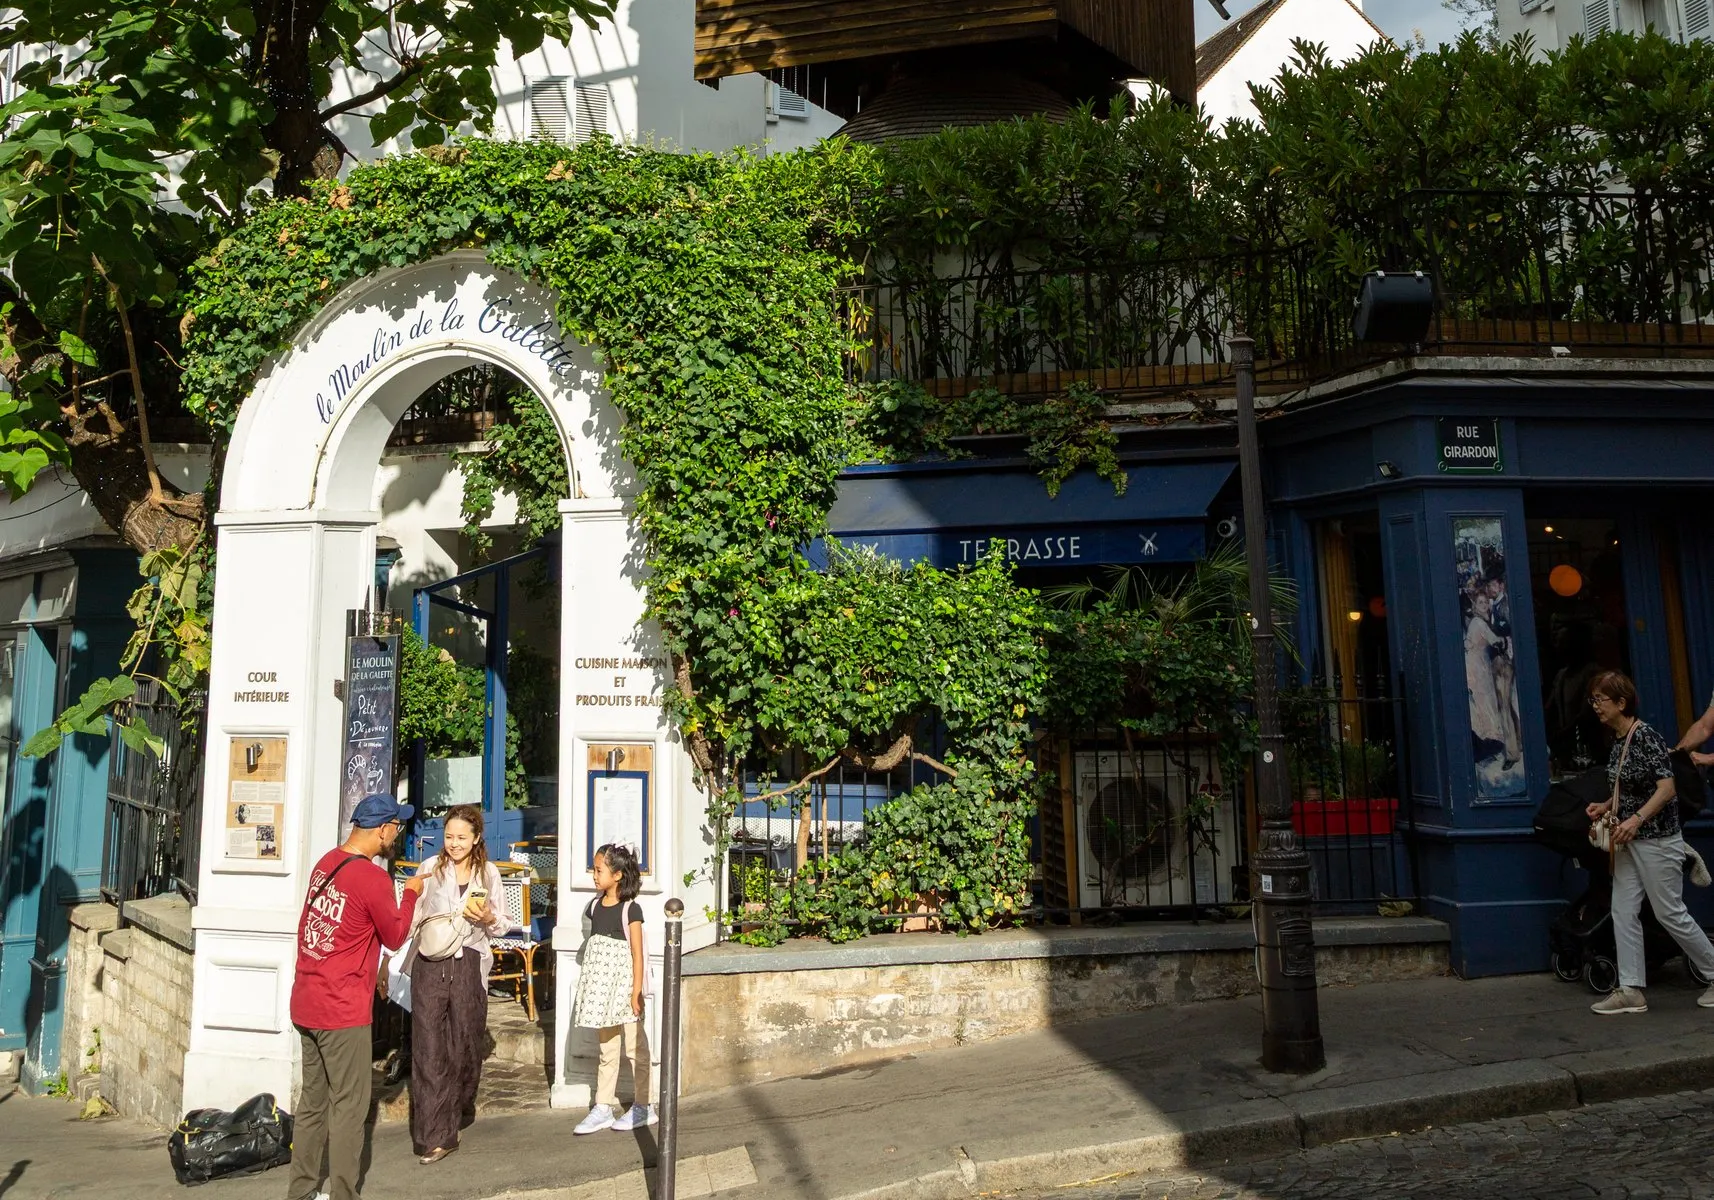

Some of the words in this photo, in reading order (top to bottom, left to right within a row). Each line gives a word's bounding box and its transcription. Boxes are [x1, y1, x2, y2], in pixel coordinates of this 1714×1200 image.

[316, 393, 335, 424] le
[328, 327, 404, 402] Moulin
[409, 310, 434, 340] de
[440, 298, 465, 332] la
[478, 298, 574, 377] Galette
[1456, 426, 1480, 439] RUE
[1443, 445, 1497, 458] GIRARDON
[960, 536, 1080, 562] TERASSE
[352, 657, 361, 669] LE
[361, 656, 394, 669] MOULIN
[574, 657, 620, 669] CUISINE
[621, 657, 668, 670] MAISON
[247, 671, 278, 683] COUR
[351, 672, 360, 681] DE
[360, 671, 368, 680] LA
[369, 670, 394, 680] GALETTE
[613, 676, 627, 688] ET
[234, 689, 290, 703] INTÉRIEURE
[575, 694, 633, 707] PRODUITS
[327, 885, 341, 901] the
